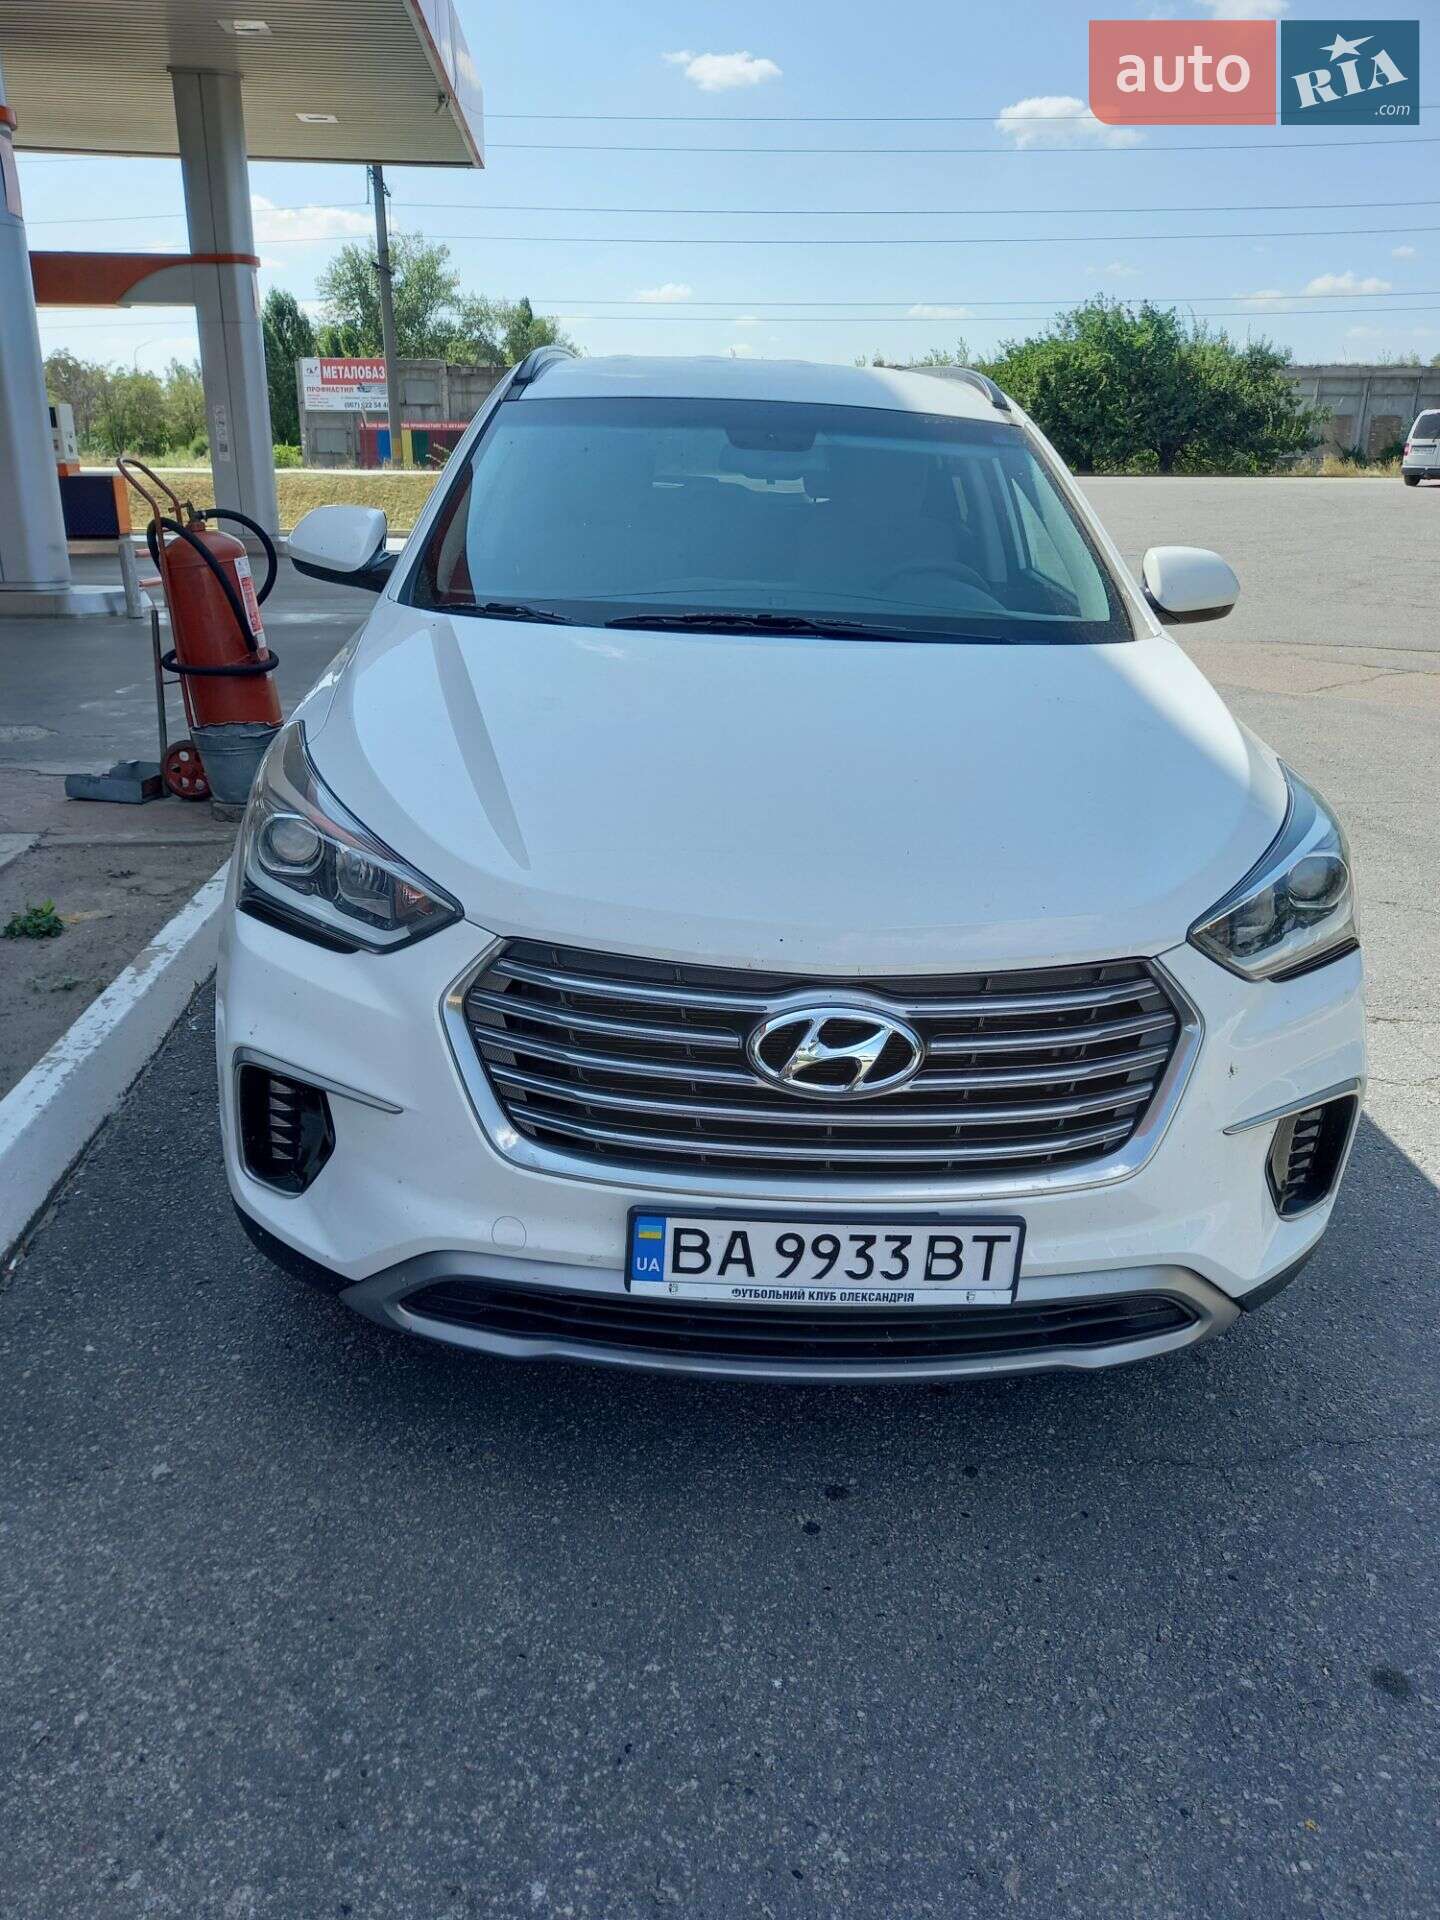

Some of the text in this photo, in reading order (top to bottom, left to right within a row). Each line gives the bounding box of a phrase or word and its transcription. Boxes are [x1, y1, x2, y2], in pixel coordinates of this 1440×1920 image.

[671, 1227, 1012, 1281] BA 9933 BT
[636, 1256, 661, 1273] UA
[731, 1288, 915, 1303] ФУТБОЛЬНИЙ КЛУБ ОЛЕКСАНДРІЯ
